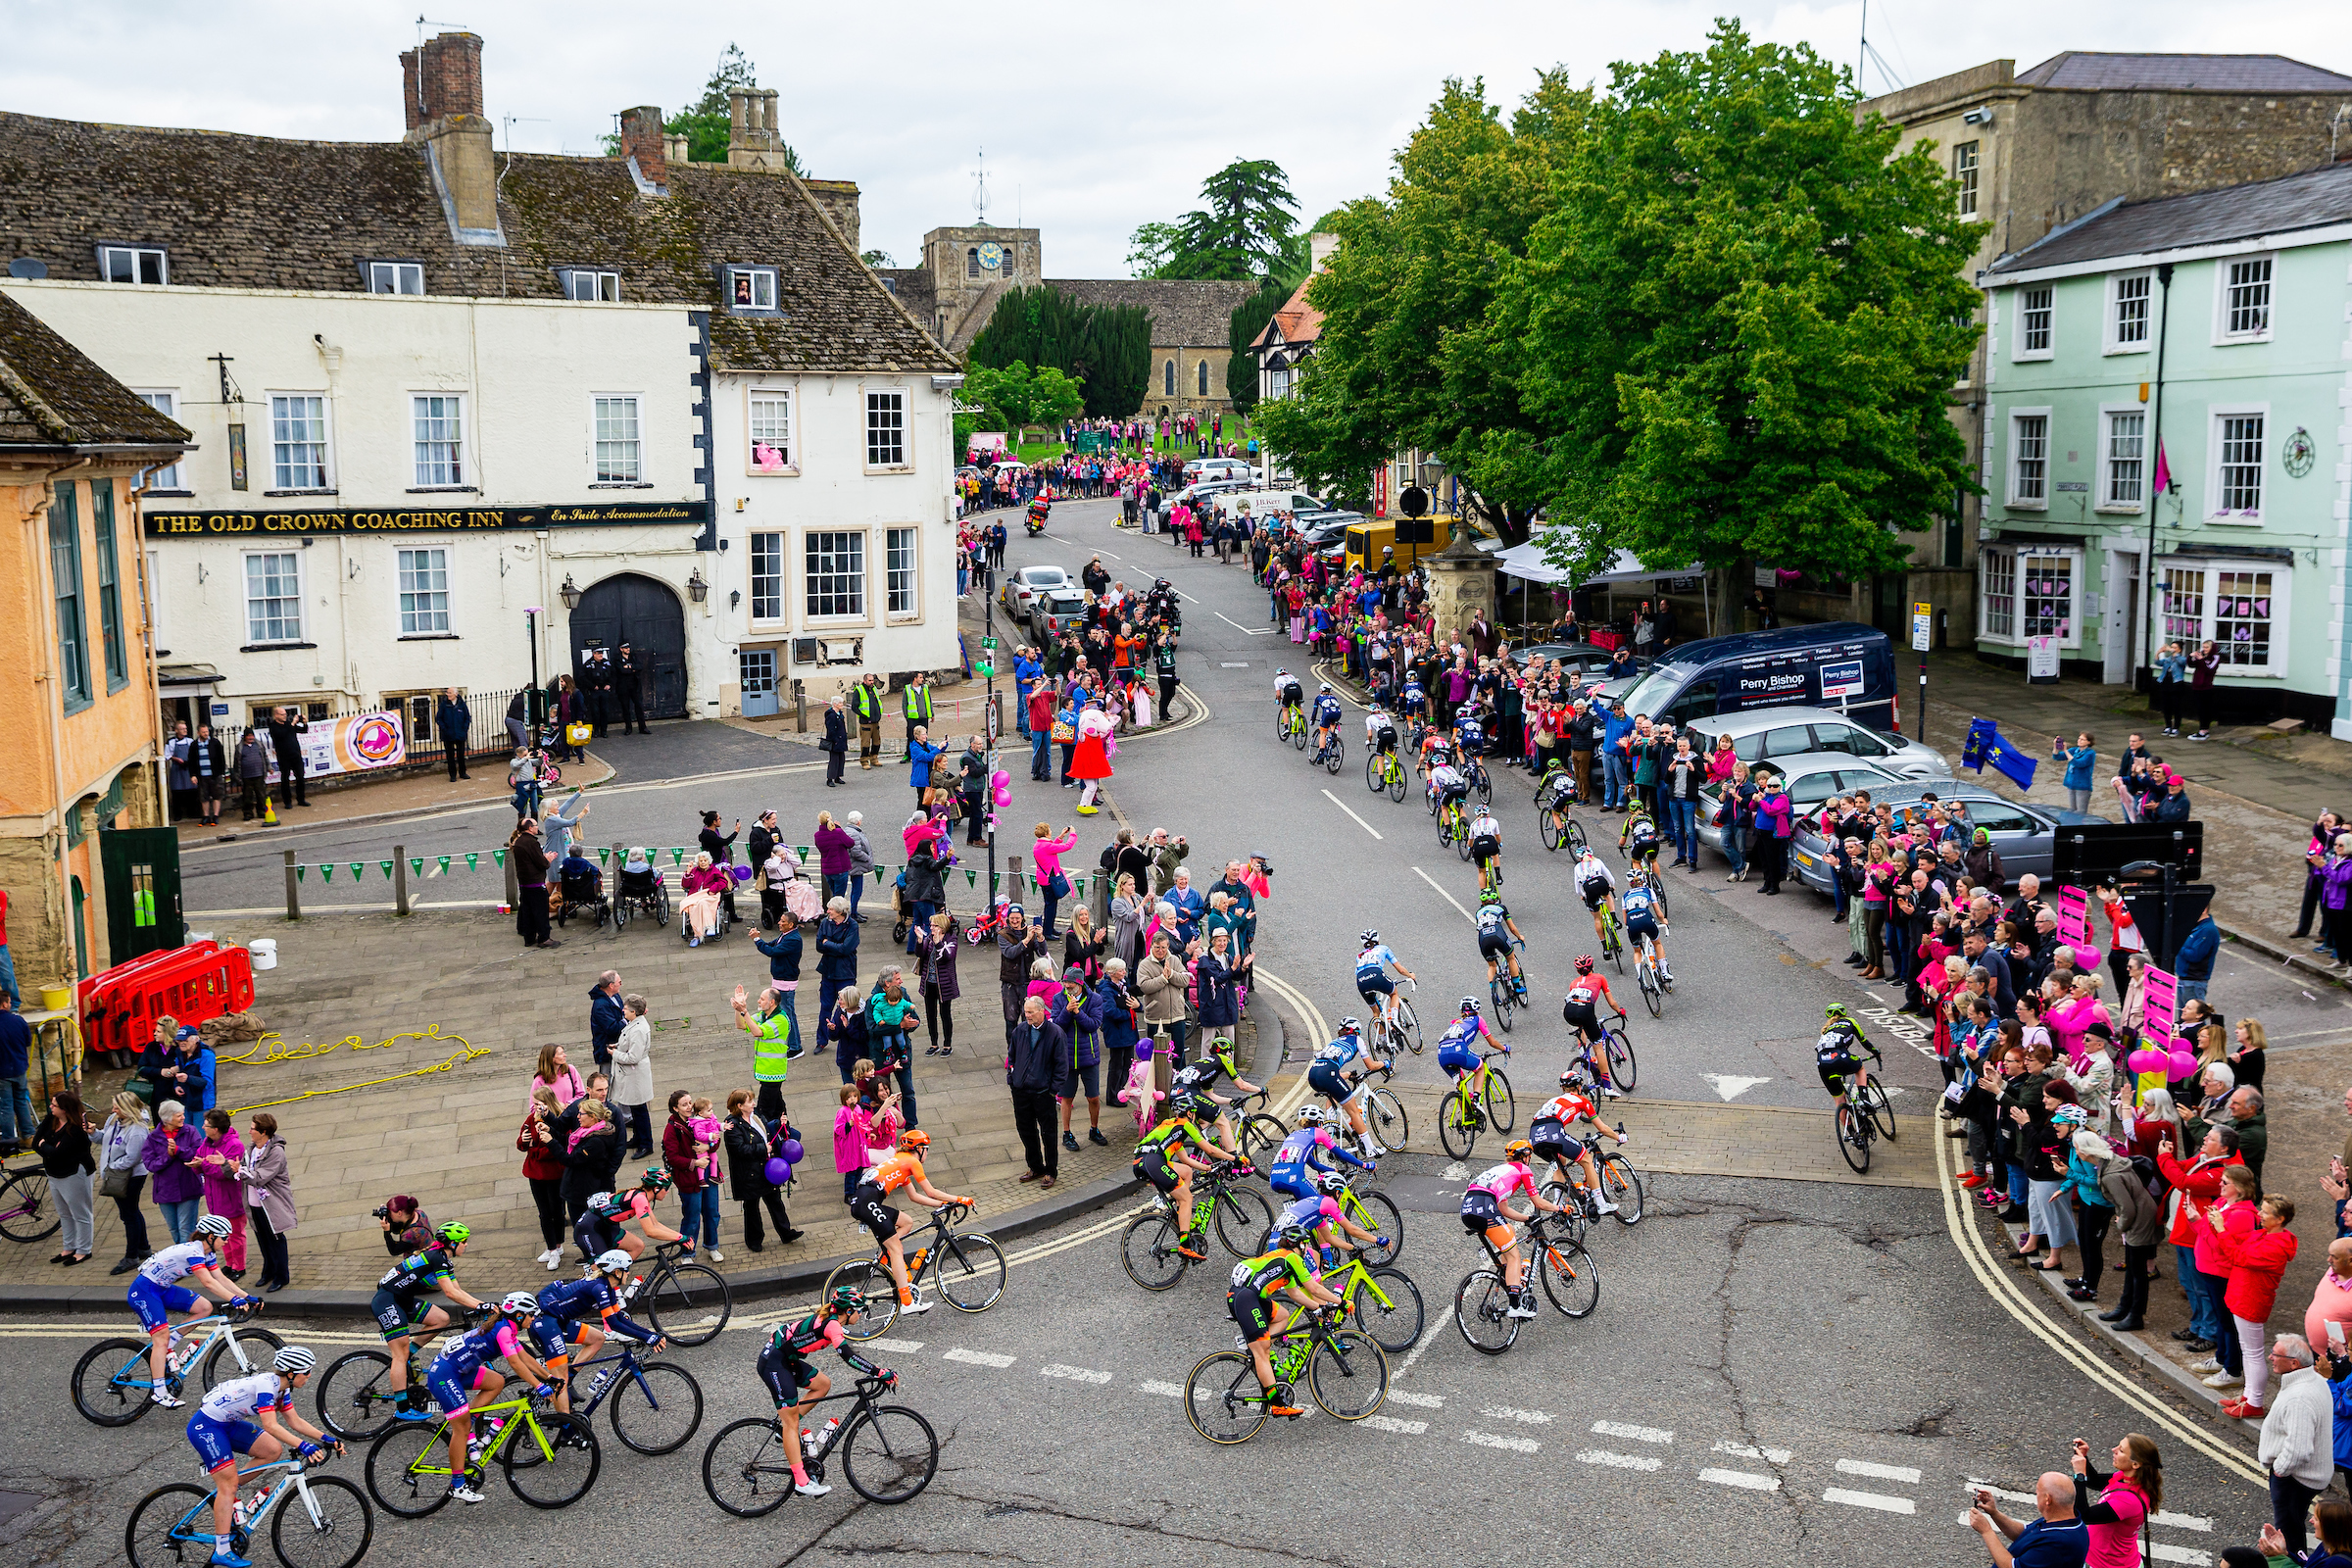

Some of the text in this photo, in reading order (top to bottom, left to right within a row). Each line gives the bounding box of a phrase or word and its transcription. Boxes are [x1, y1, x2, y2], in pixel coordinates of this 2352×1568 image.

[154, 512, 504, 533] THE OLD CROWN COACHING INN
[551, 508, 691, 521] En Suite Accommodation
[1740, 673, 1805, 690] Perry Bishop
[319, 723, 333, 733] ARTS
[298, 735, 320, 746] ESTIVAL
[1856, 1007, 1941, 1061] DISABLE
[1194, 1094, 1217, 1107] SCOTT
[885, 1169, 903, 1182] CCC
[867, 1201, 887, 1223] CCC
[1200, 1195, 1216, 1235] CIPOLLINI
[968, 1235, 992, 1246] GIANT
[605, 1256, 623, 1265] KASK
[845, 1261, 869, 1270] GIANT
[394, 1273, 417, 1290] TIBCO
[938, 1270, 949, 1295] GIANT
[983, 1288, 1002, 1307] GIANT
[385, 1304, 401, 1325] TIBCO
[550, 1334, 566, 1354] VIRTU
[1287, 1339, 1314, 1385] CIPOLLINI
[446, 1378, 466, 1405] VALCAR
[595, 1366, 623, 1400] STORCK
[478, 1413, 519, 1465] cannondale
[828, 1414, 854, 1450] FACTOR
